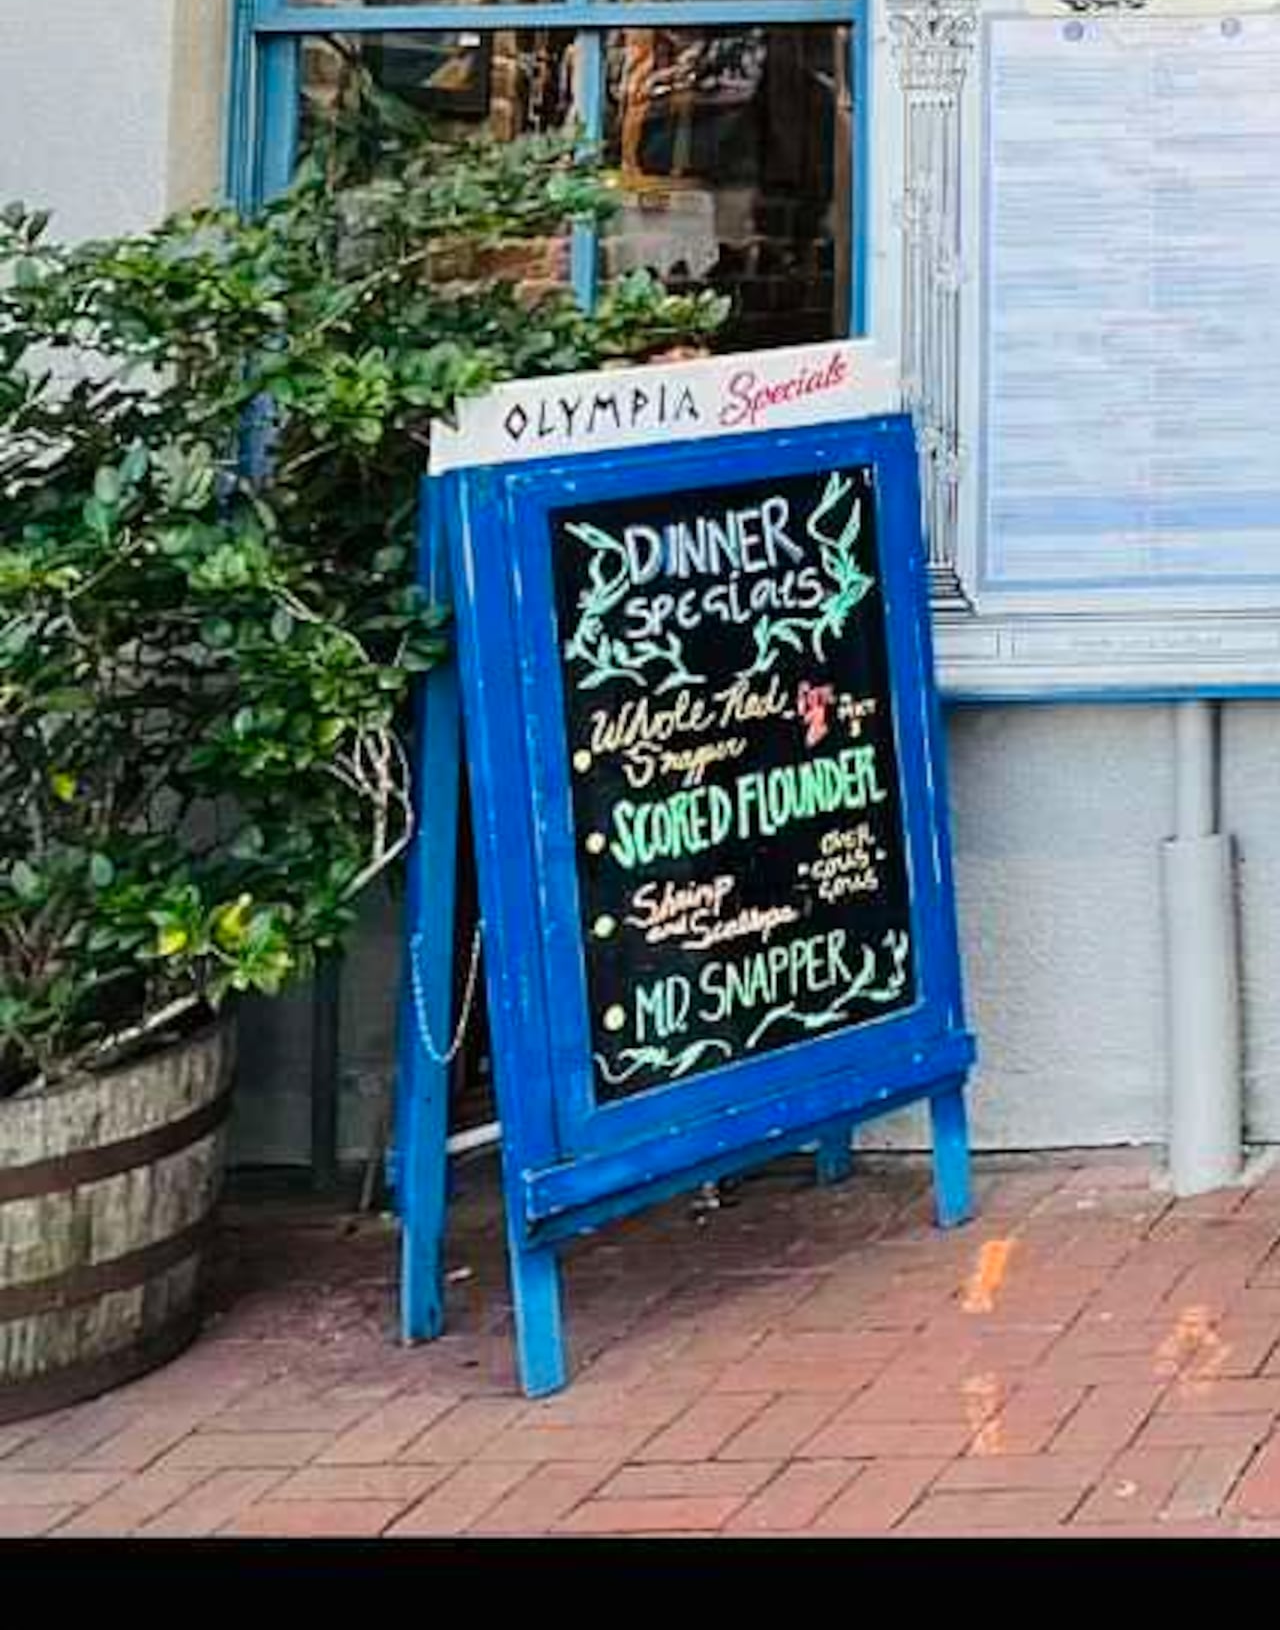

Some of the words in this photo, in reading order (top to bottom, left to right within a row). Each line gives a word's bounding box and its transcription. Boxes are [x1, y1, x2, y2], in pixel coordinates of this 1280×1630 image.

[504, 382, 700, 441] OLYMPIA
[719, 352, 847, 427] Specials
[623, 496, 803, 584] DINNER
[609, 785, 732, 868] SCORED
[734, 744, 887, 839] FLOUNDER
[697, 928, 852, 1023] SNAPPER
